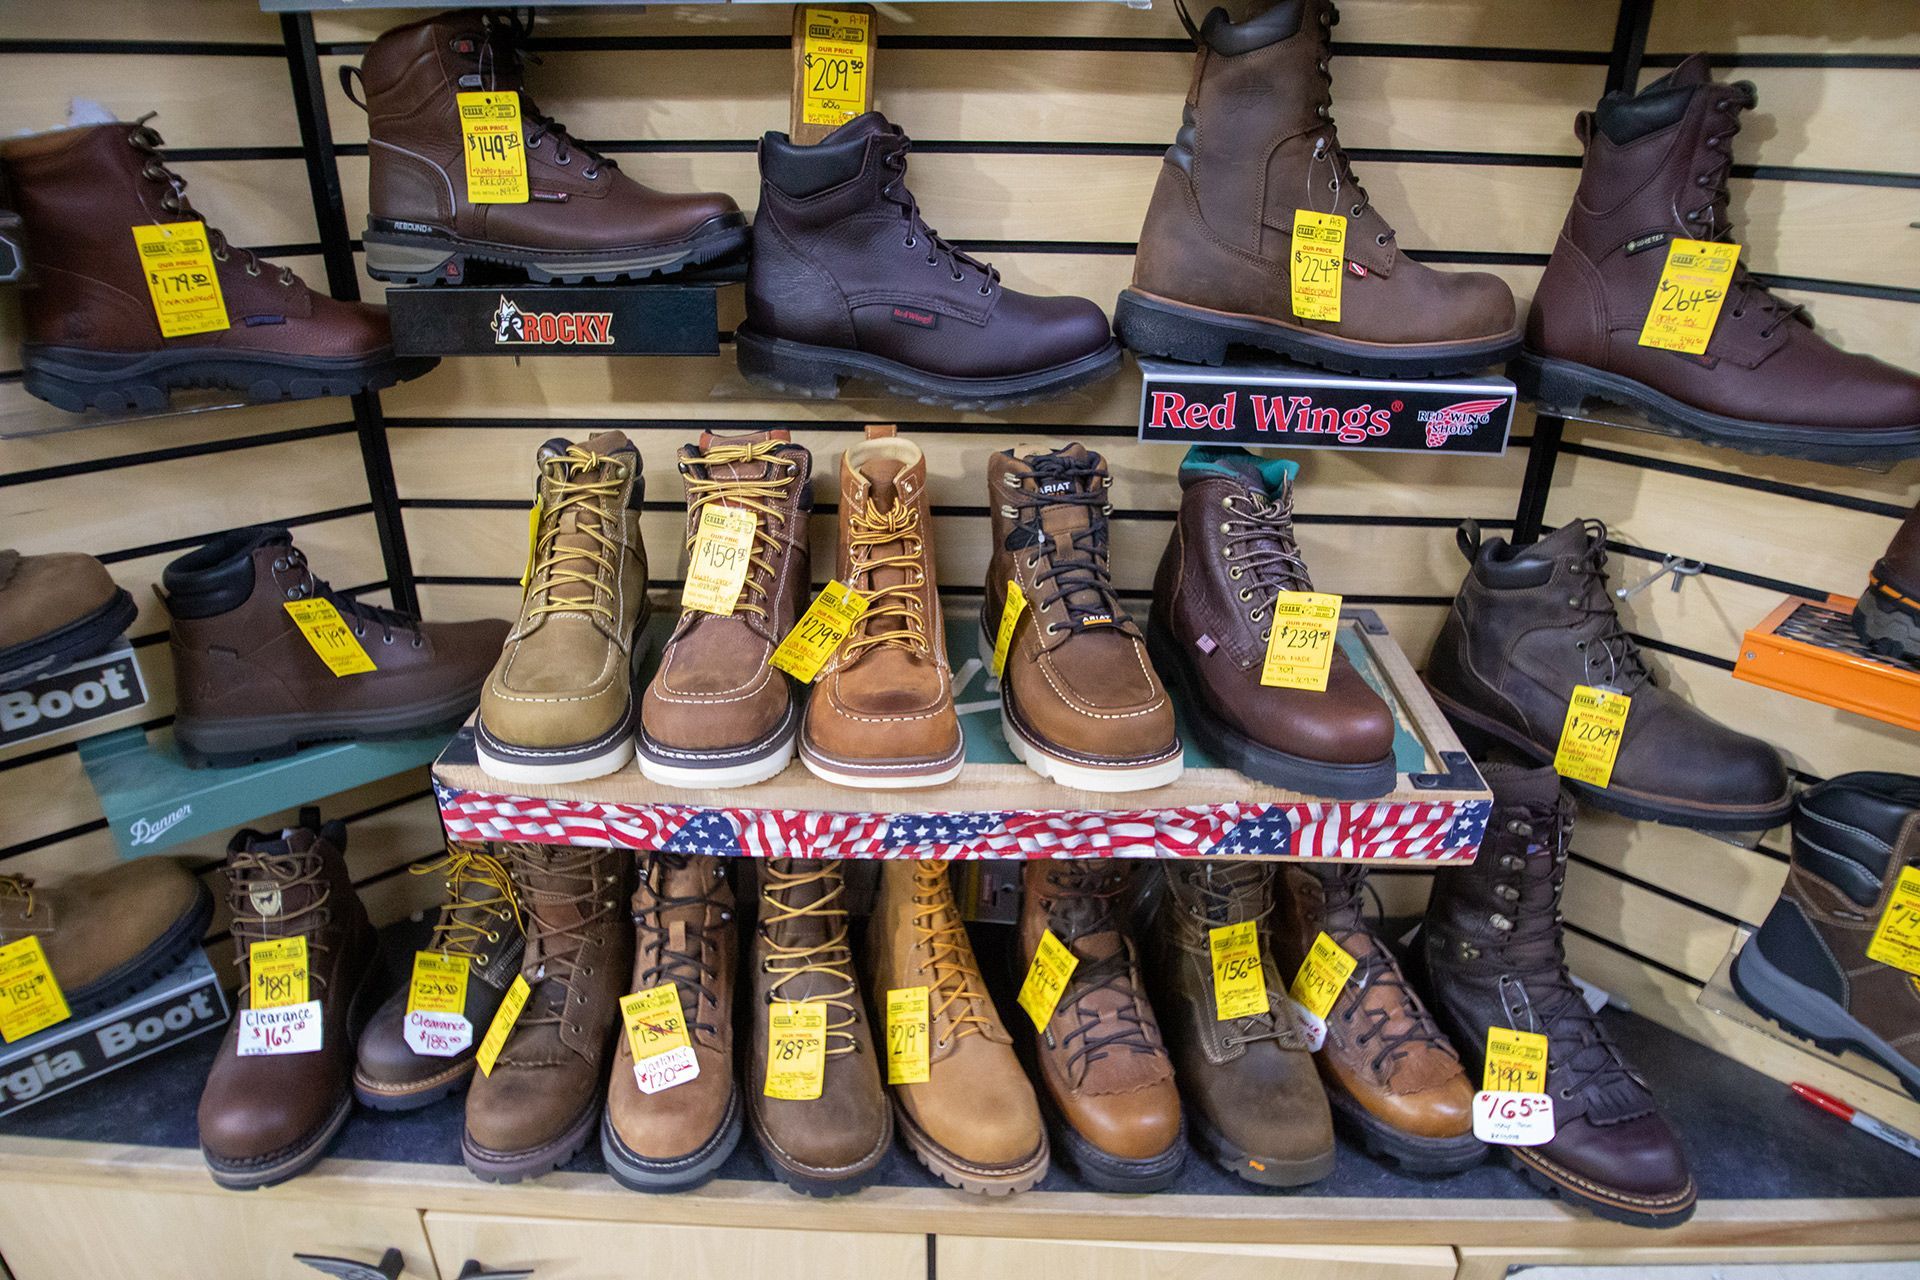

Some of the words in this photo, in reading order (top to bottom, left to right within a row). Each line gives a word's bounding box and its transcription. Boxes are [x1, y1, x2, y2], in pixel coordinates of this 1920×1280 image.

[1316, 246, 1332, 254] PRICE
[521, 312, 613, 343] ROCKY
[1149, 391, 1237, 431] Red
[1250, 394, 1391, 444] Wings
[1417, 410, 1444, 422] RED
[1449, 411, 1490, 425] WING
[1431, 424, 1473, 436] SHOES
[1082, 614, 1111, 623] ARIAT
[0, 667, 130, 732] Boot
[130, 804, 193, 847] Danner
[96, 991, 214, 1060] Boot
[245, 1006, 313, 1027] Clearance
[411, 1012, 466, 1032] Clearance
